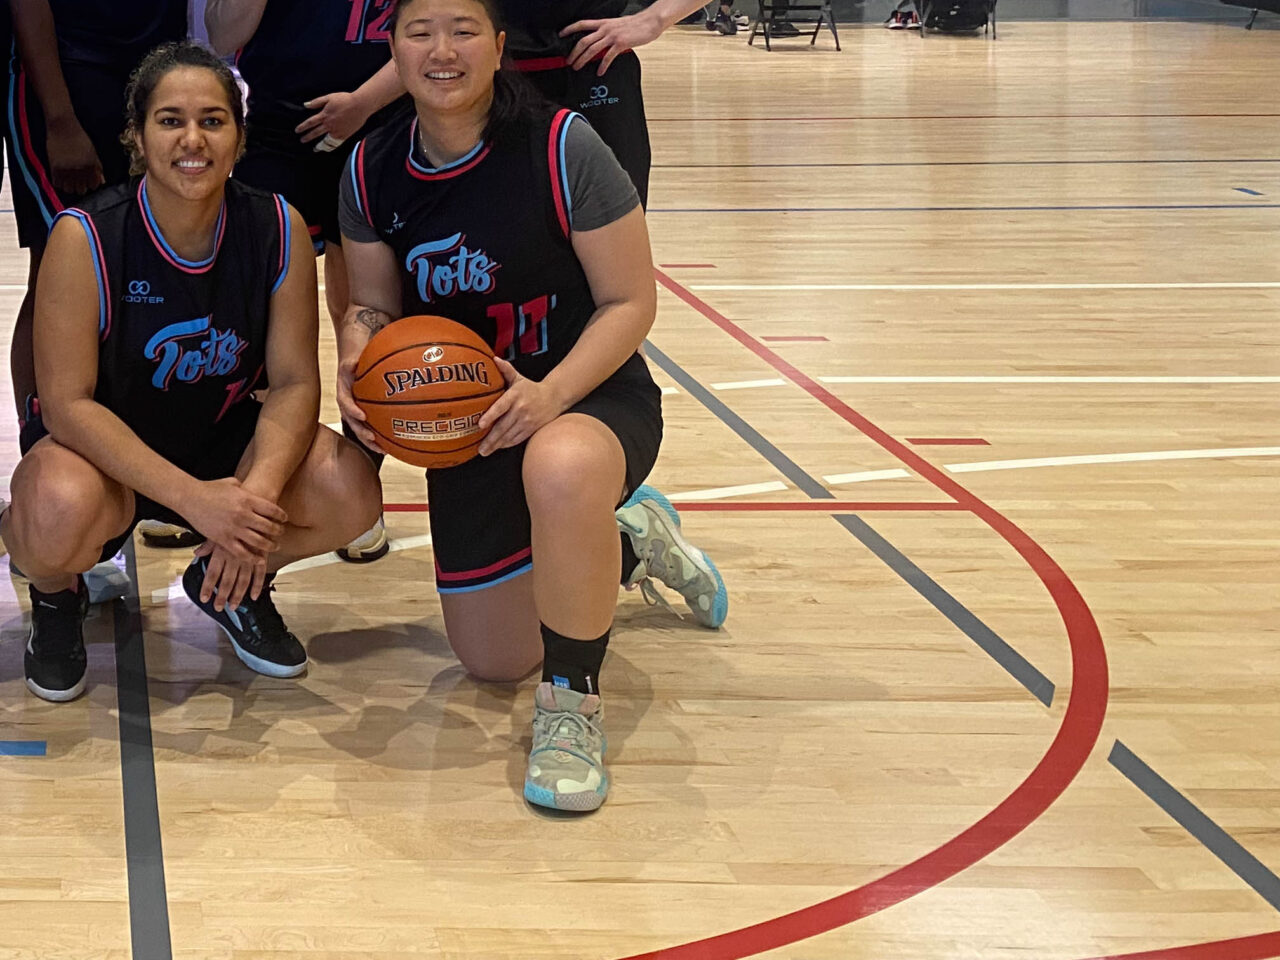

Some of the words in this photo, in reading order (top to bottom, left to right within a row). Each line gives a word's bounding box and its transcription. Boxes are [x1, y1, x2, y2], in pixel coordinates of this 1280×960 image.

[405, 232, 503, 305] Tots
[144, 313, 249, 392] Tots
[382, 360, 491, 399] SPALDING
[391, 410, 488, 433] PRECISIO
